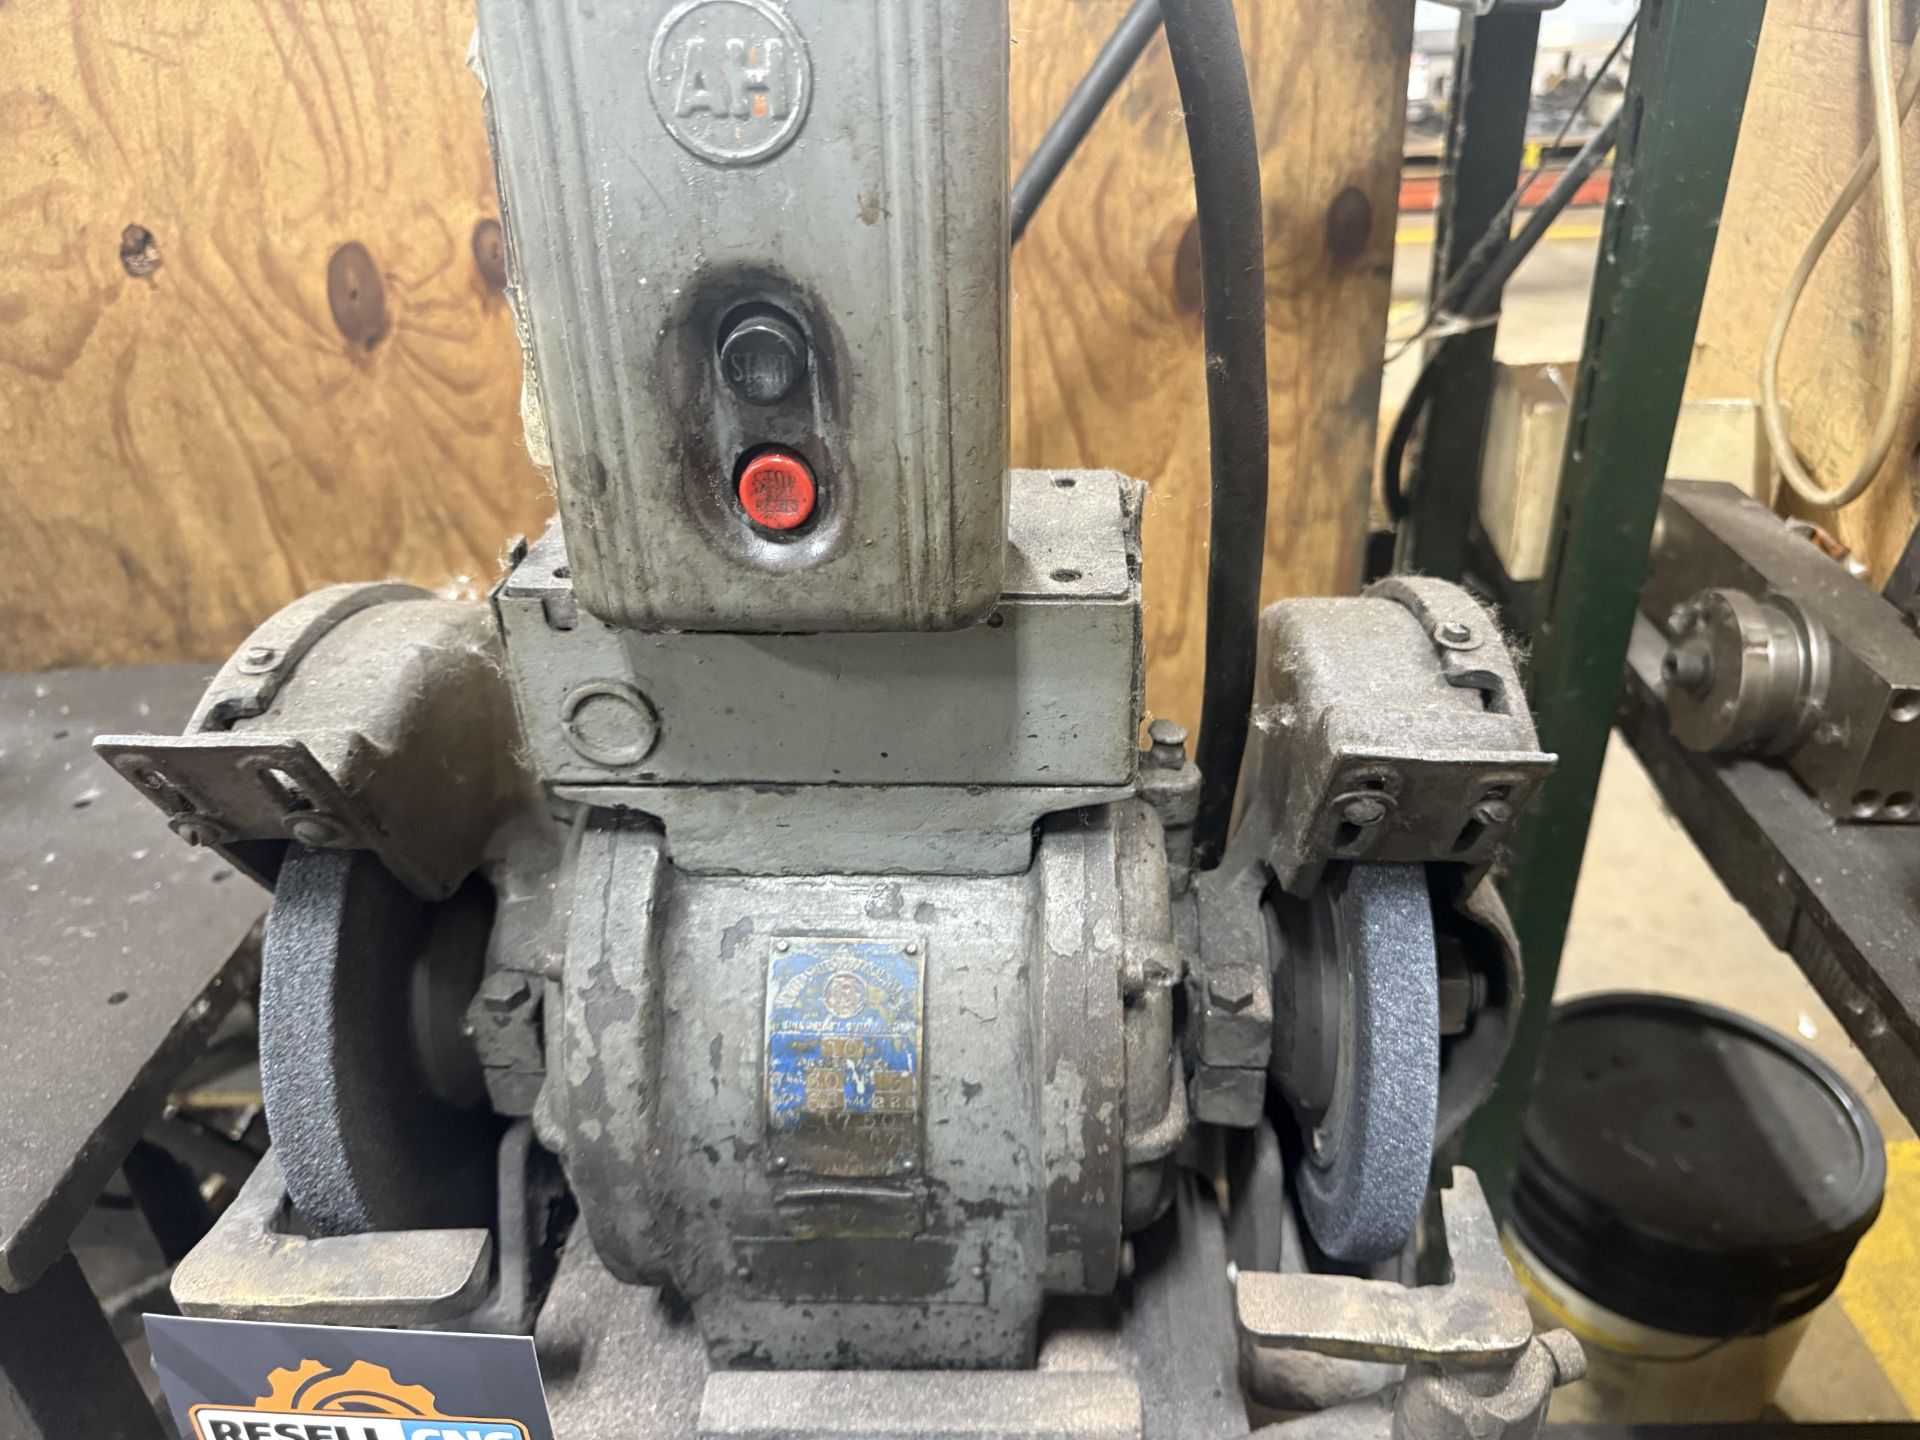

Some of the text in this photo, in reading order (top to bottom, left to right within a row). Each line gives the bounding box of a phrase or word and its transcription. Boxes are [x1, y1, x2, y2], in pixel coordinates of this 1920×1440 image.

[674, 37, 790, 119] AH
[731, 351, 788, 386] START
[752, 470, 796, 492] STOP
